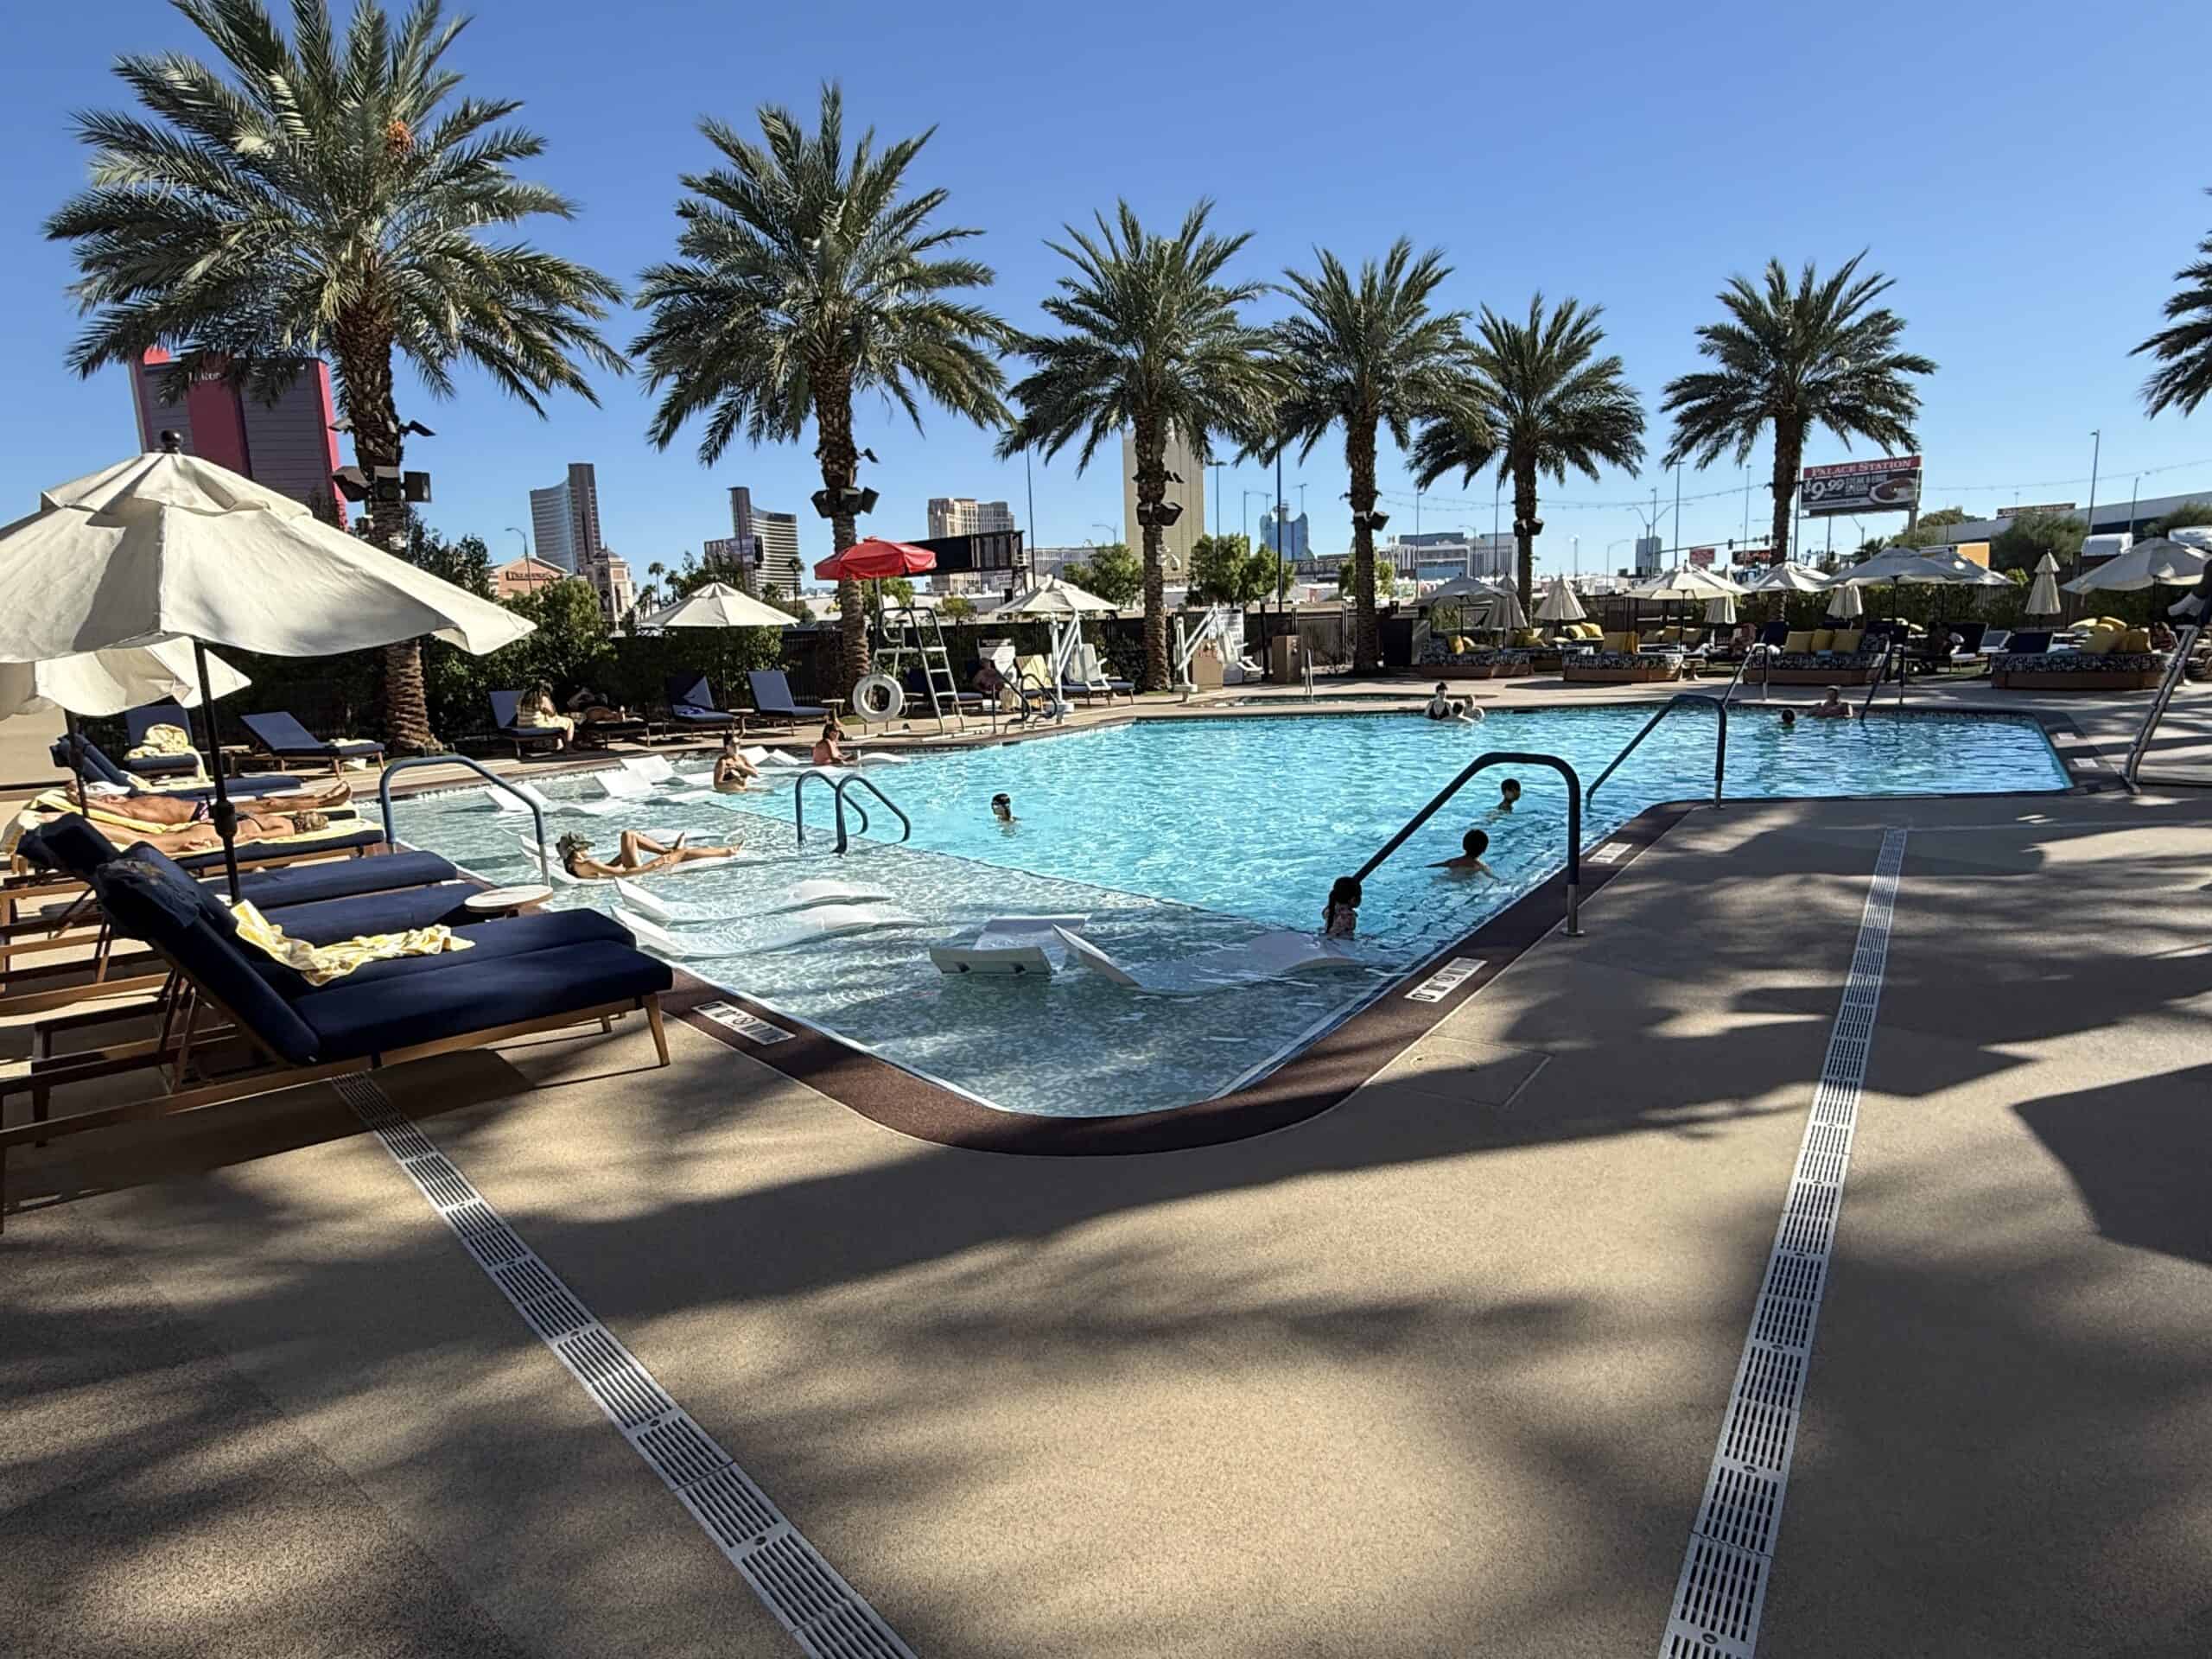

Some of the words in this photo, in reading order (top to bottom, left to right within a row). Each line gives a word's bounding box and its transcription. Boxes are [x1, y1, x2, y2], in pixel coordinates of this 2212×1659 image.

[1811, 464, 1857, 477] PALACE
[1859, 460, 1911, 472] STATION
[1803, 479, 1846, 500] $9.99
